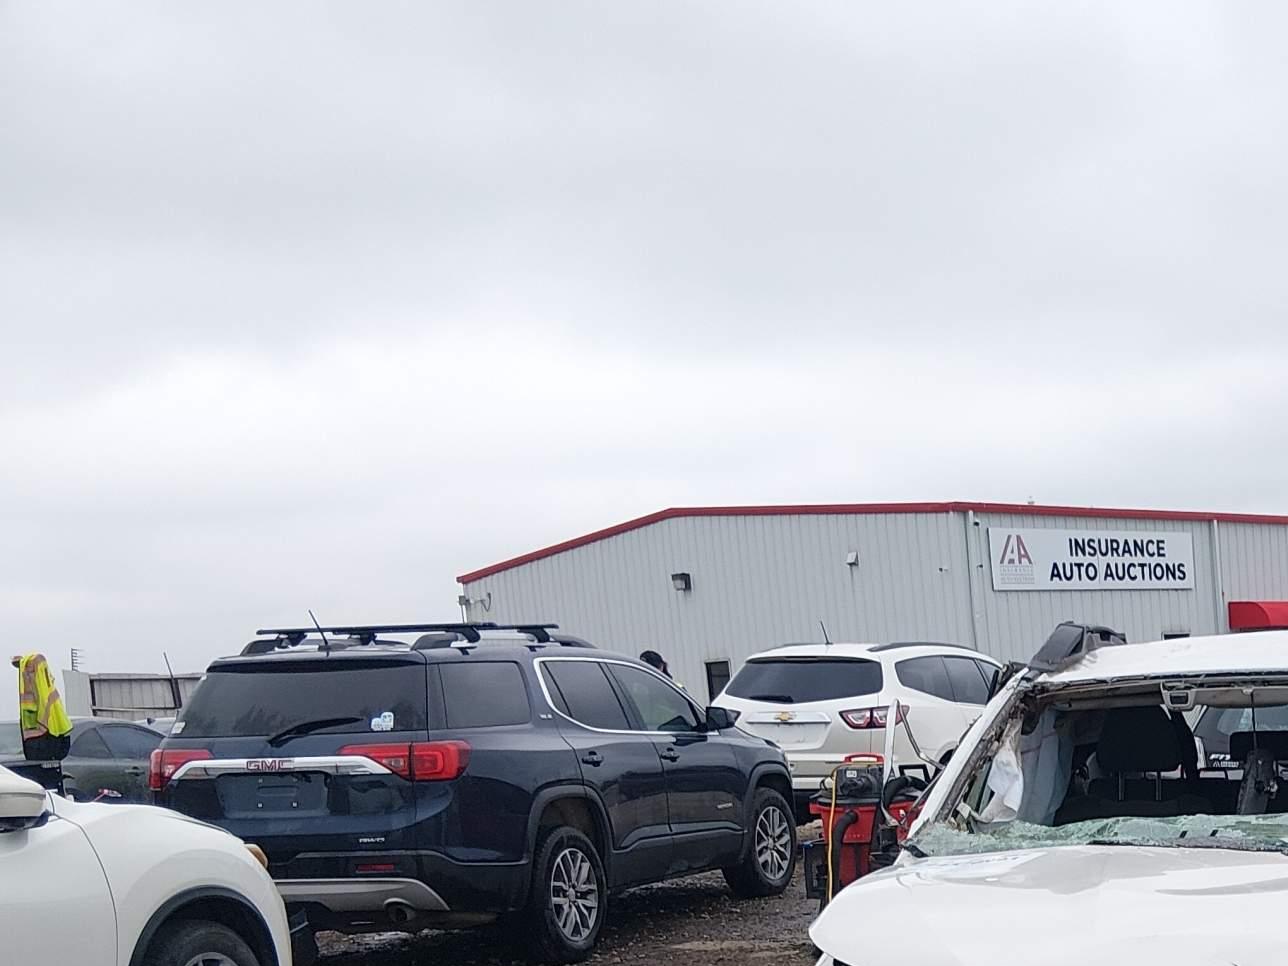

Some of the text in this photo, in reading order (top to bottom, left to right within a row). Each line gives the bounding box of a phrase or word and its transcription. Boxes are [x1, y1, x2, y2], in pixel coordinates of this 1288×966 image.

[1068, 537, 1166, 558] INSURANCE
[1050, 562, 1098, 582] AUTO
[1103, 562, 1187, 581] AUCTIONS
[246, 759, 294, 771] GMC
